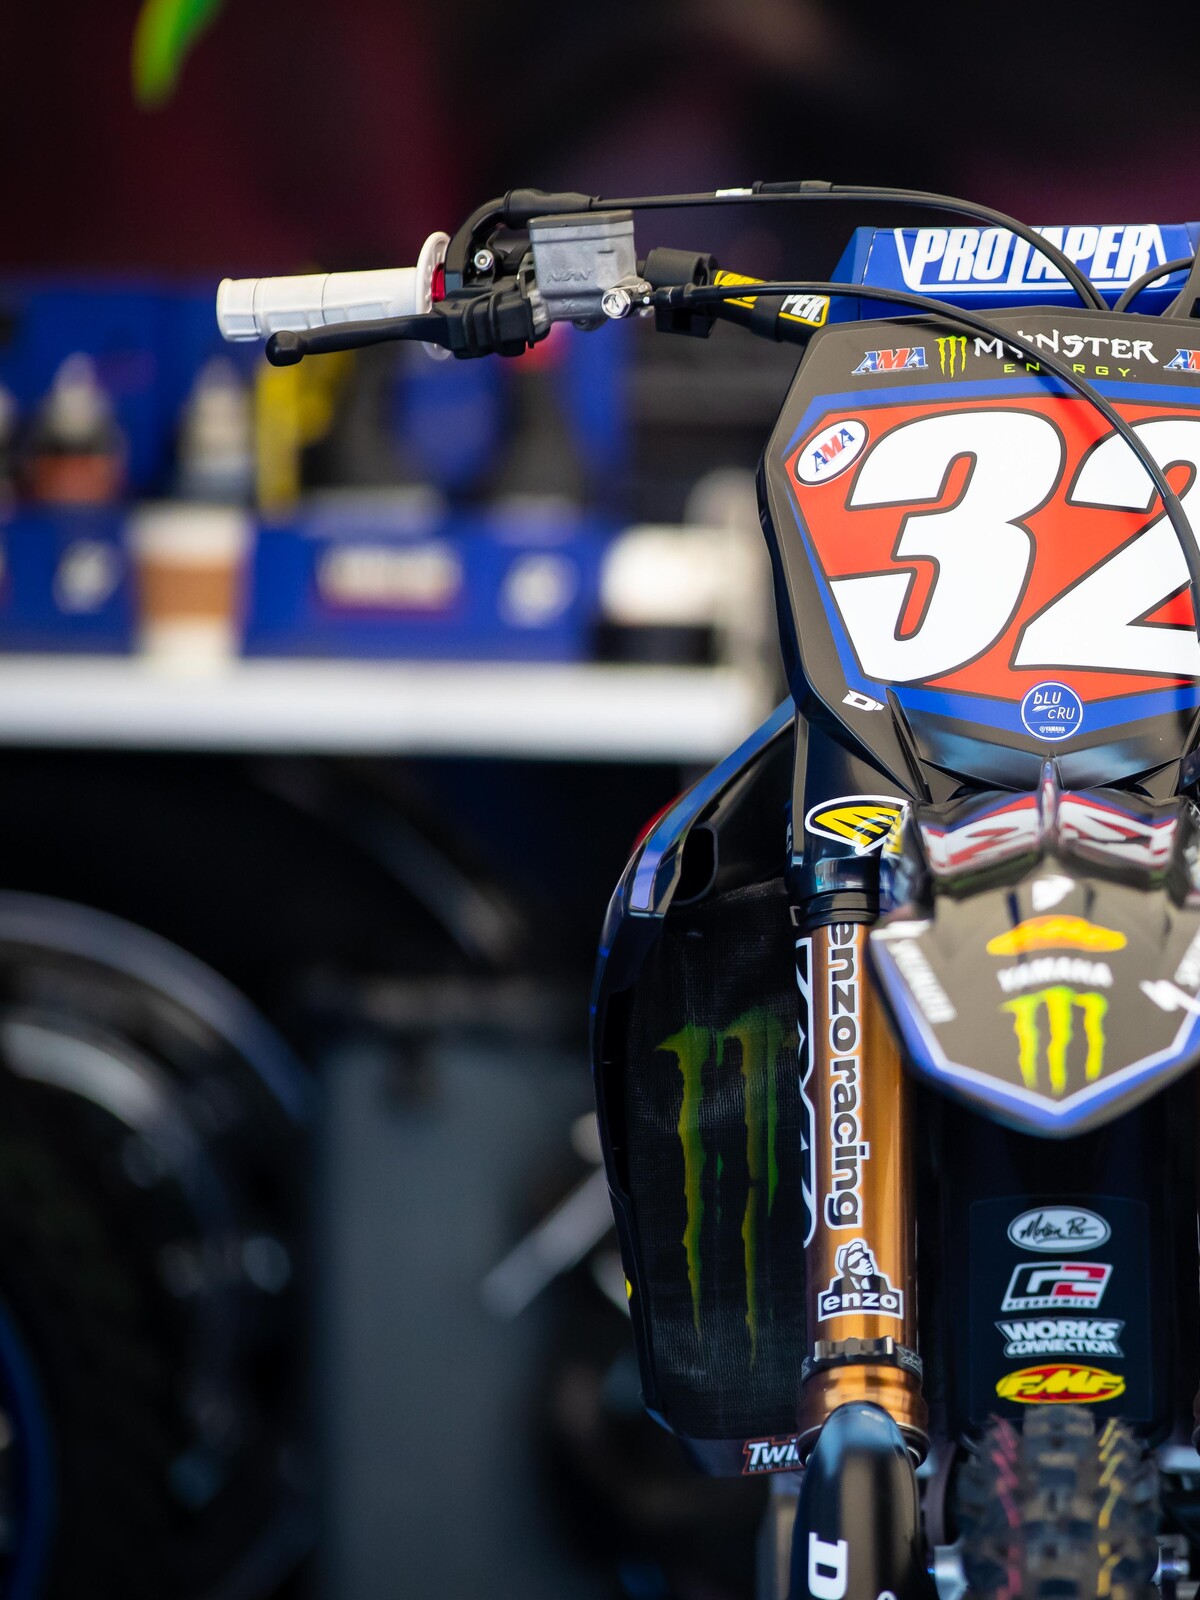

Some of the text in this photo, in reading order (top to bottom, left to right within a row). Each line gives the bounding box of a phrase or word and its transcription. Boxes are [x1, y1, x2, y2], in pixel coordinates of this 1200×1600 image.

[851, 347, 929, 373] AMA
[1003, 362, 1131, 378] ENRGY
[812, 428, 855, 472] AMA
[823, 1291, 898, 1311] enzo
[1001, 1320, 1119, 1341] WORKS
[1006, 1339, 1118, 1355] CONNECTION
[997, 1368, 1124, 1397] FMF
[748, 1438, 799, 1465] Twi
